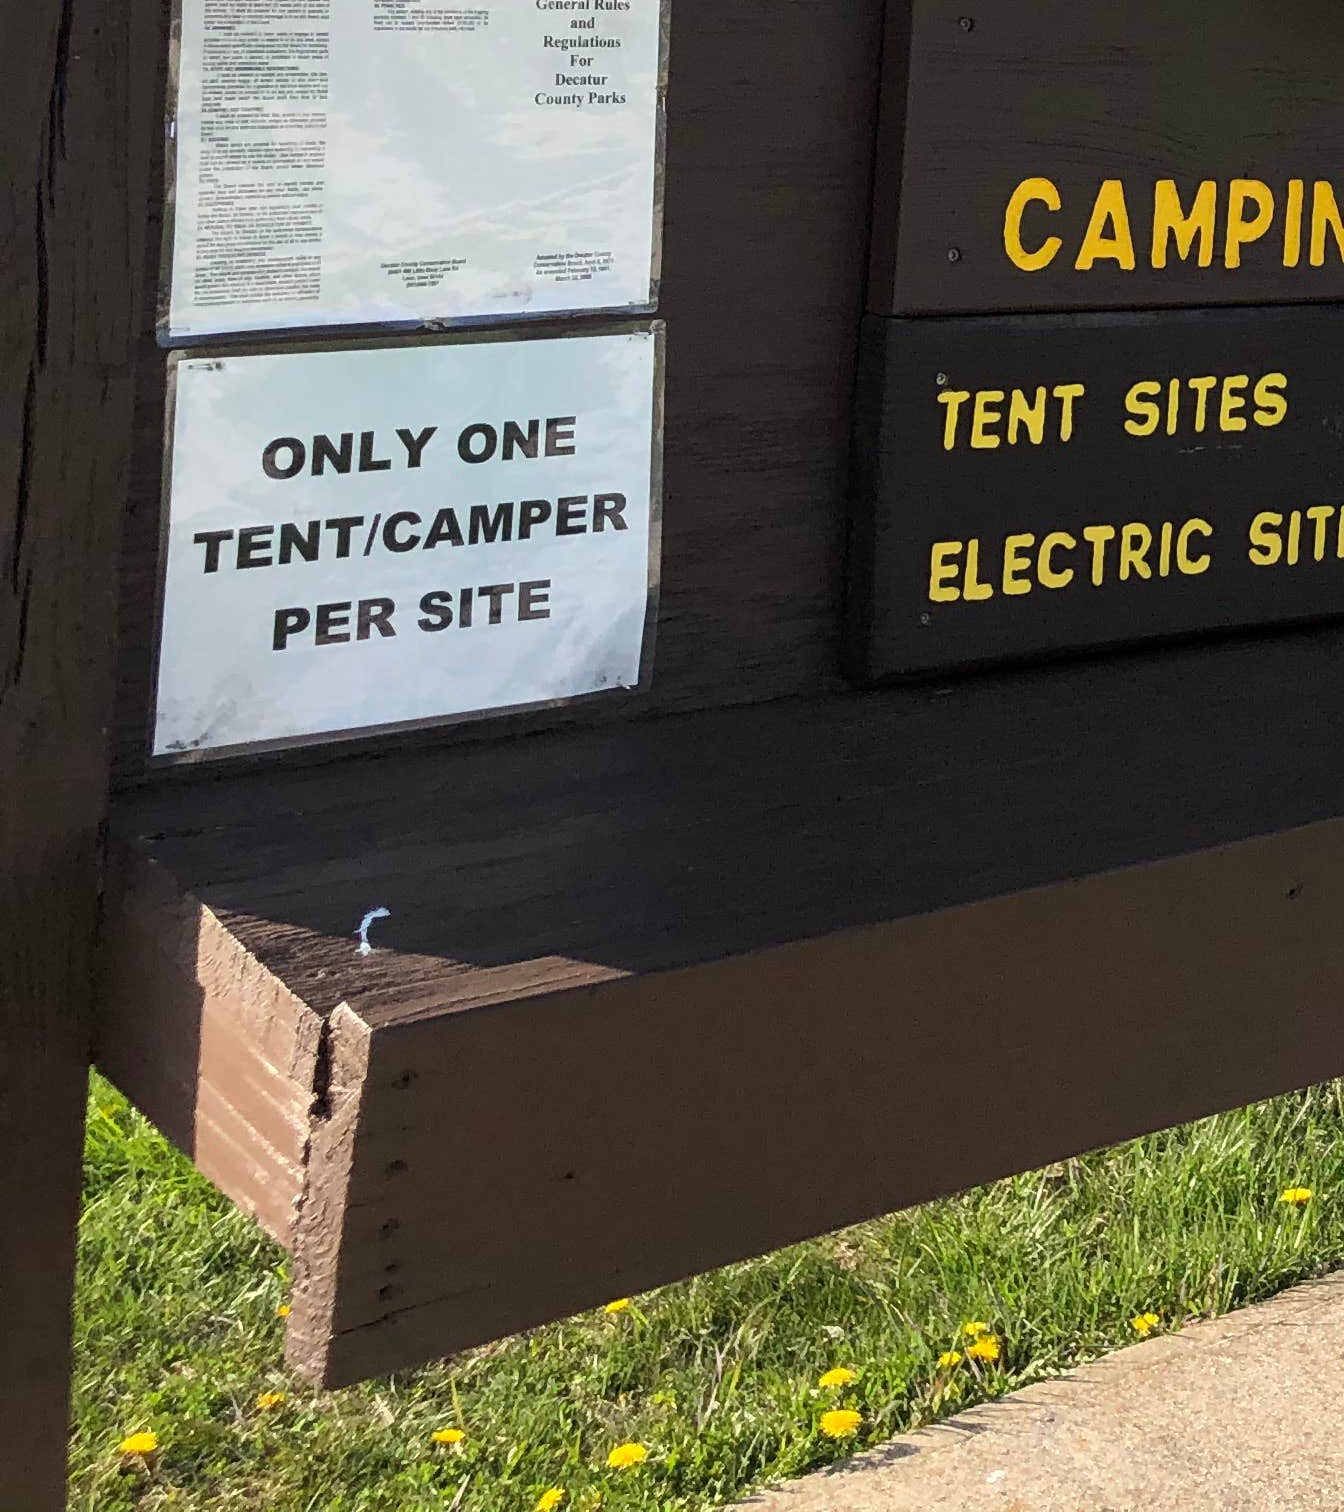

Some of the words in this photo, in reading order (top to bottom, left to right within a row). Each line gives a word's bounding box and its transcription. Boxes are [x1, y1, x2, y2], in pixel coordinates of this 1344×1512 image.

[570, 17, 594, 29] and
[544, 36, 621, 51] Regulations
[570, 55, 594, 66] For
[555, 73, 608, 86] Decatur
[535, 93, 584, 108] County
[588, 92, 626, 104] Parks
[937, 384, 1084, 450] TENT
[1124, 373, 1287, 436] SITES
[262, 427, 438, 479] ONLY
[458, 416, 576, 464] ONE
[194, 493, 627, 573] TENT/CAMPER
[929, 518, 1212, 602] ELECTRIC
[272, 598, 396, 650] PER
[418, 579, 551, 632] SITE
